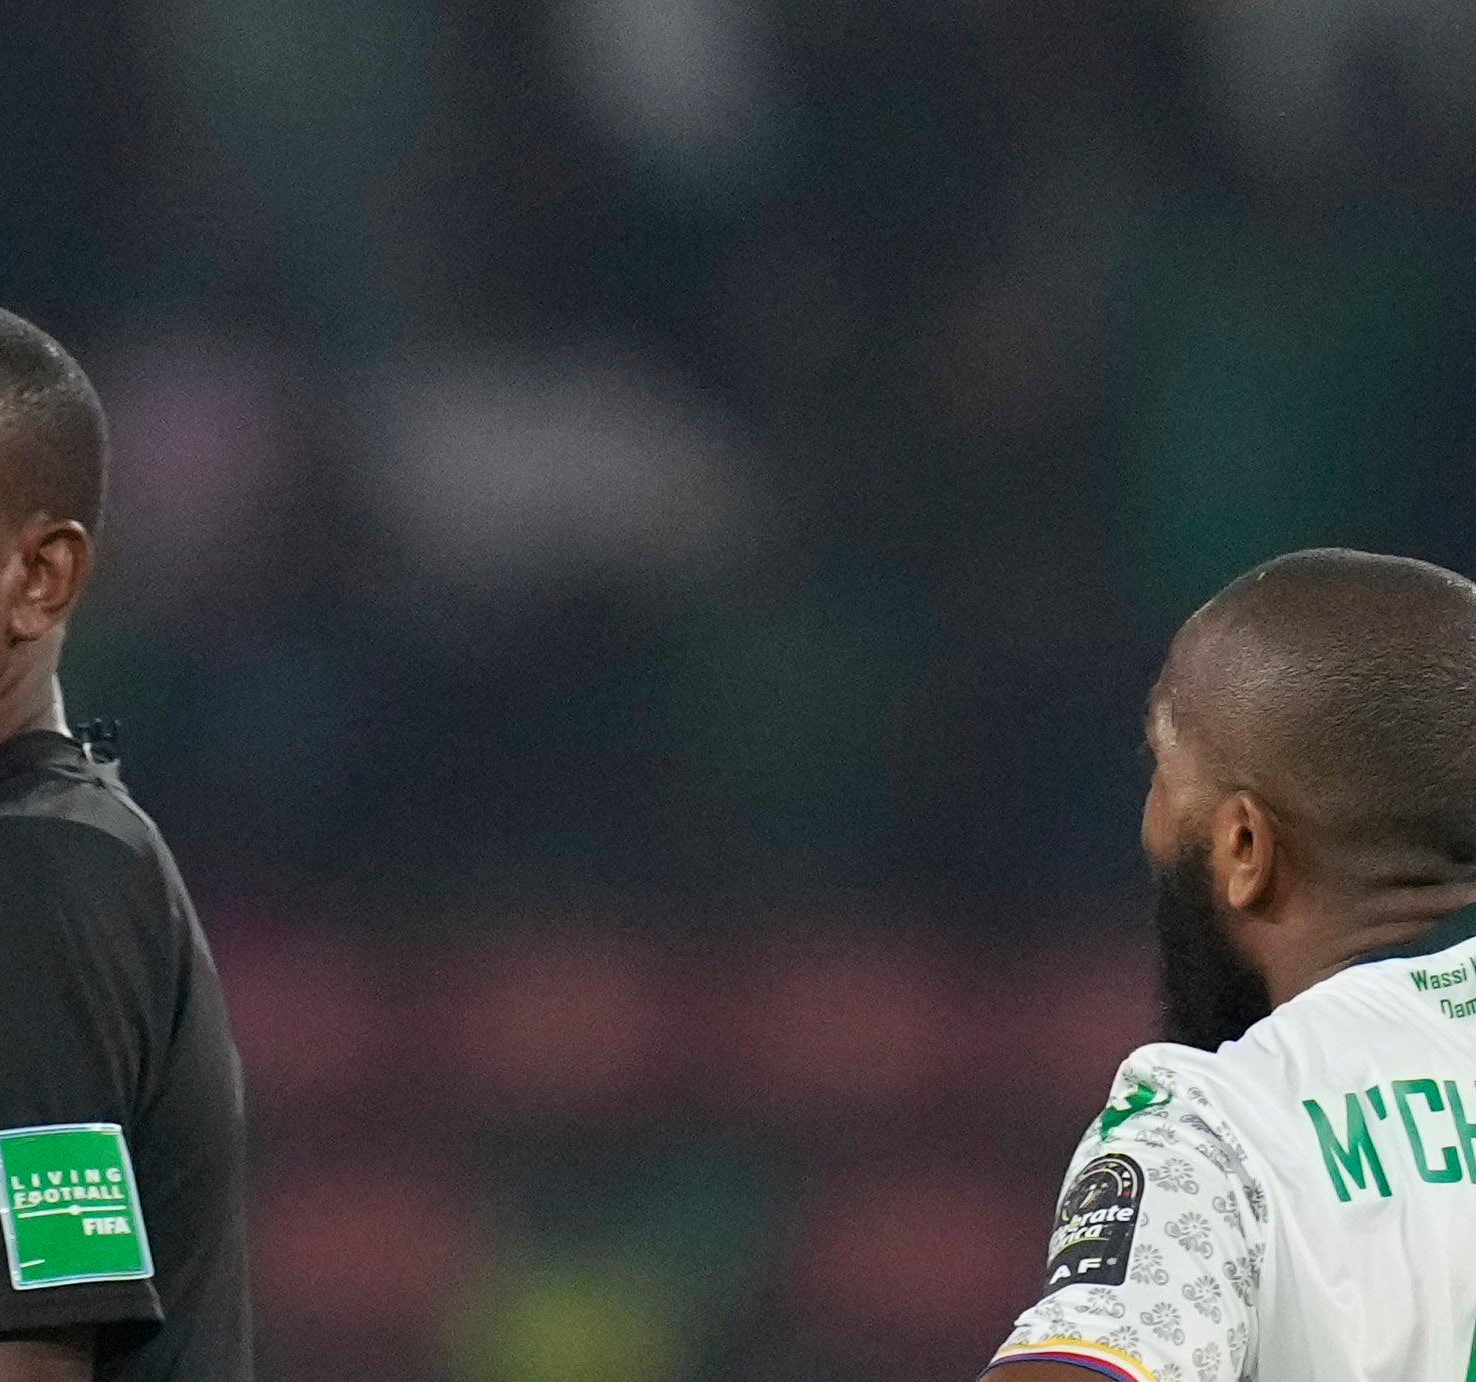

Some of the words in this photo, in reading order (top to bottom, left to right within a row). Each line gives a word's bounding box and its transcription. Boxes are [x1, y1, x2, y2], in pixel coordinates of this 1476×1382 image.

[1410, 962, 1468, 992] Wassi
[11, 1167, 122, 1191] LIVING
[13, 1185, 124, 1209] FOOTBALL
[82, 1216, 131, 1236] FIFA
[1049, 1257, 1103, 1286] AF
